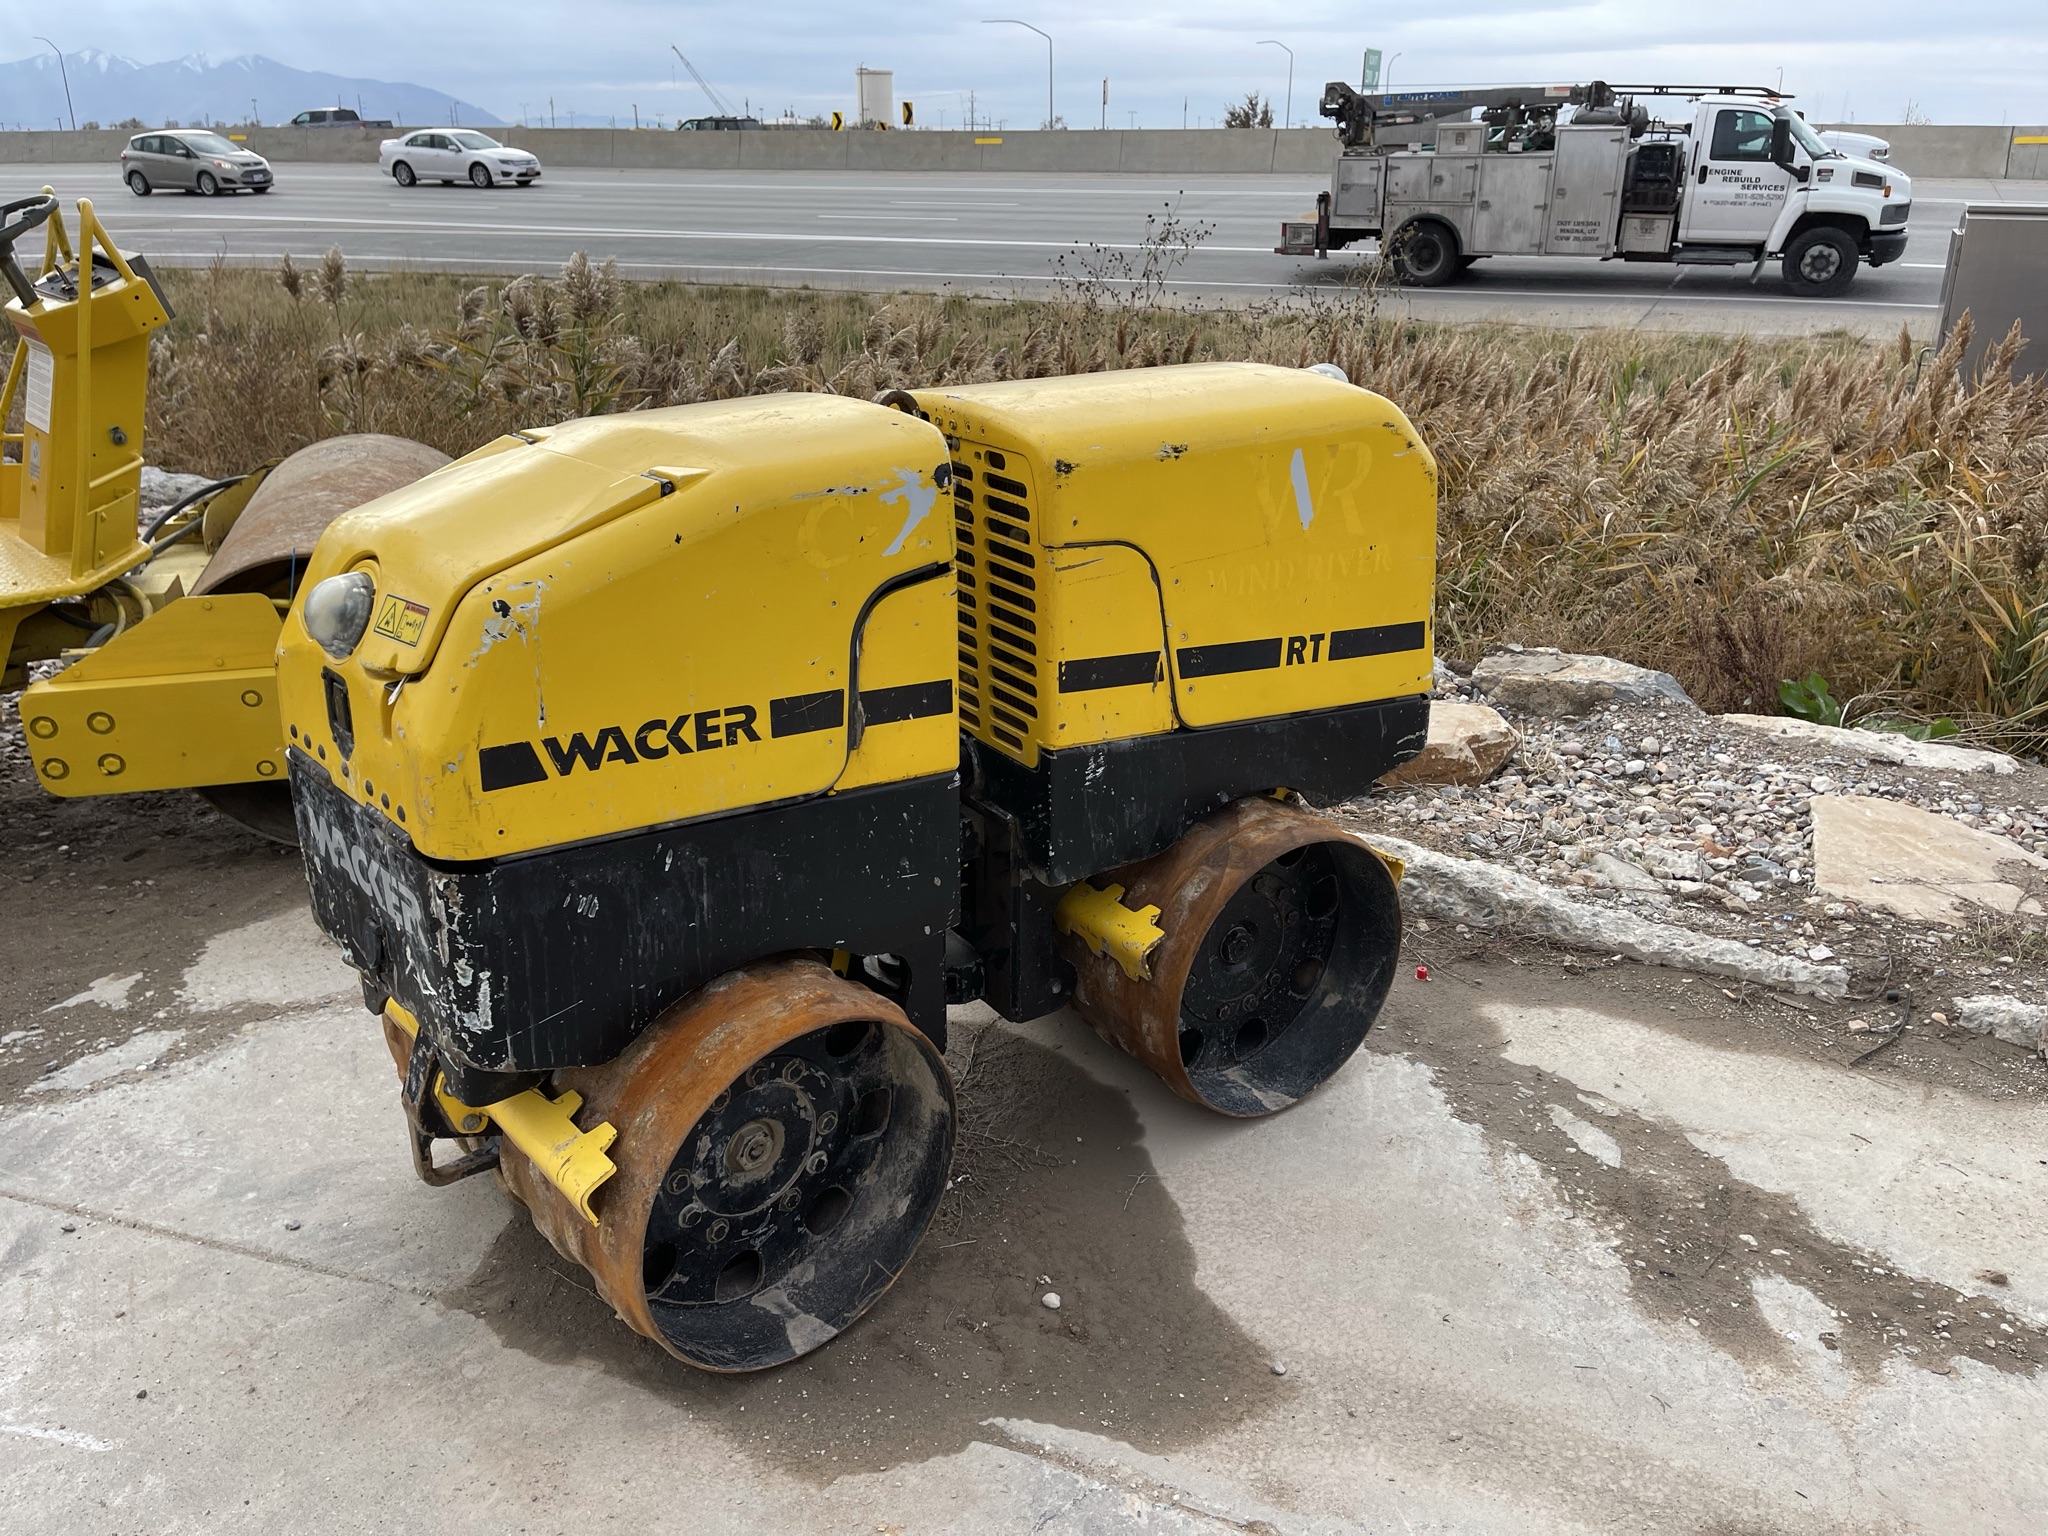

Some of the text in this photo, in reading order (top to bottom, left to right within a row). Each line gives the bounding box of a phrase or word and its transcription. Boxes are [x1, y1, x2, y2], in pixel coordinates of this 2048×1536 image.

[1286, 633, 1326, 666] RT
[542, 704, 761, 776] WACKER
[306, 805, 425, 938] WACKER
